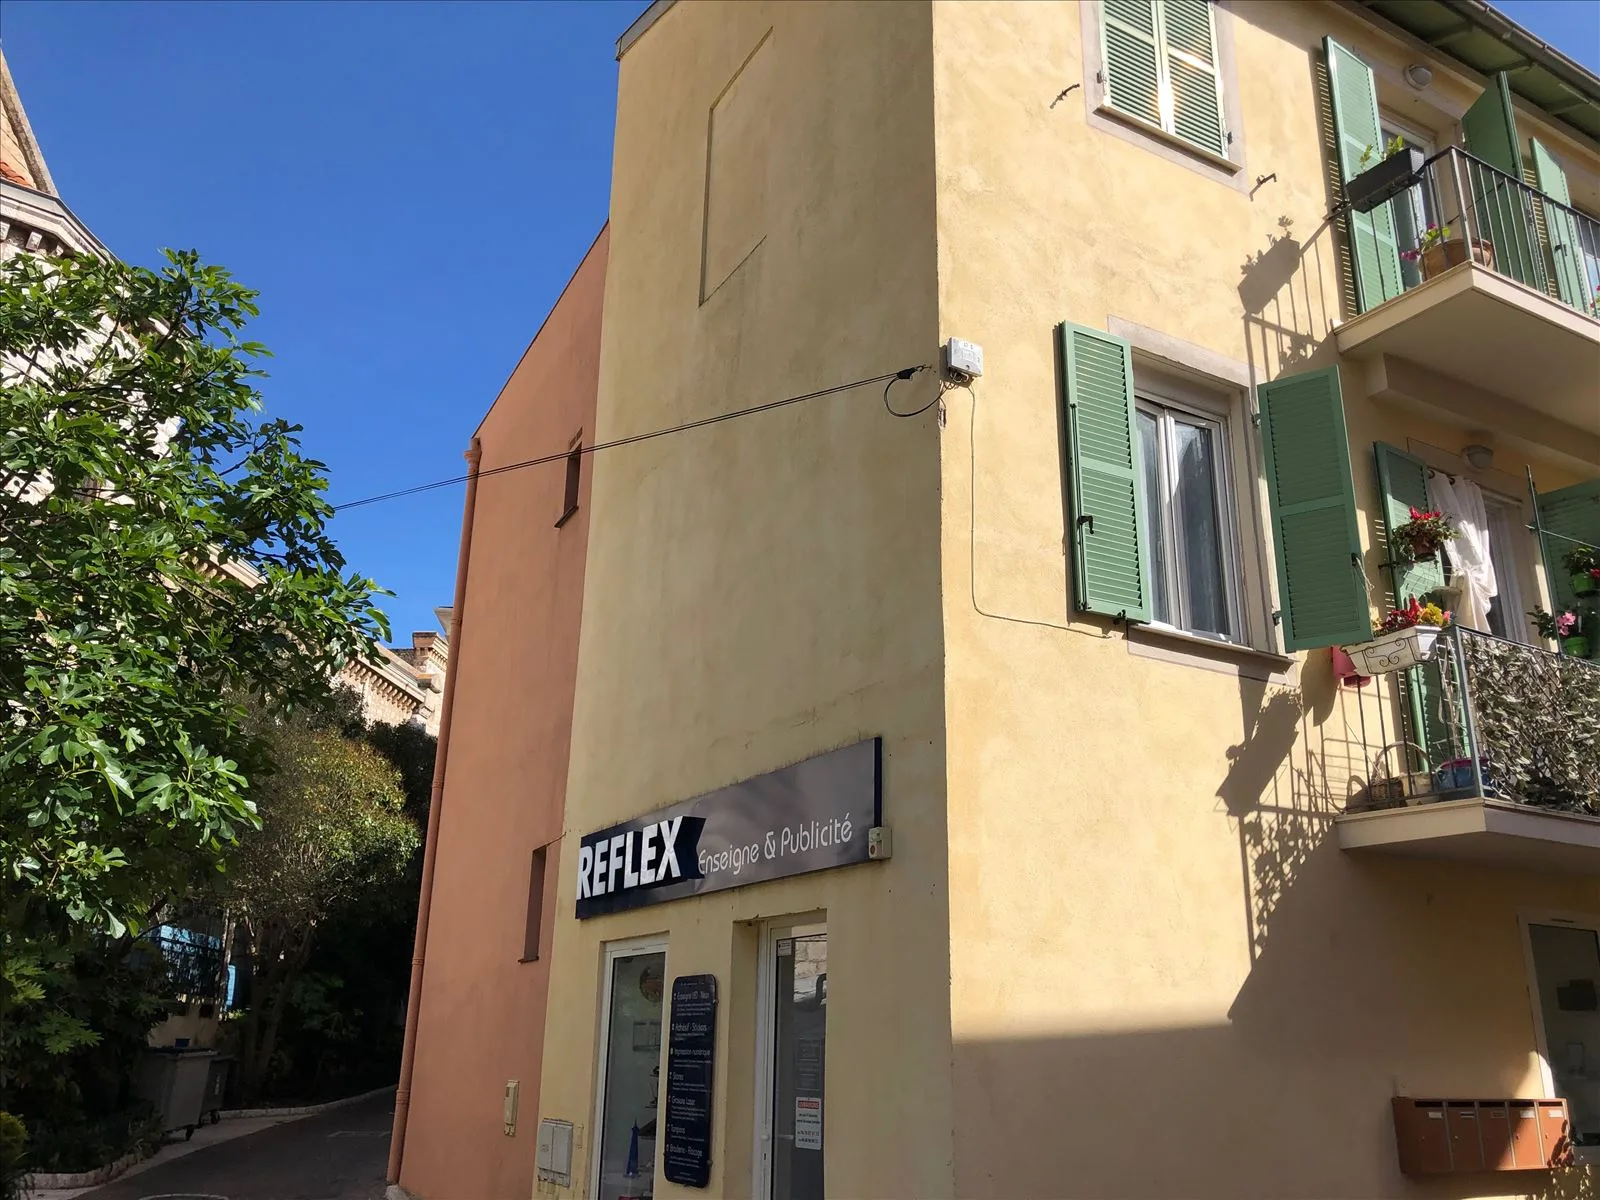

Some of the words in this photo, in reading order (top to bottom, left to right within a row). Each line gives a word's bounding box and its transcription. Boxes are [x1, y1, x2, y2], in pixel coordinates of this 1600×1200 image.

[576, 815, 684, 900] REFLEX
[698, 843, 760, 876] Enseigne
[763, 831, 776, 858] &
[781, 812, 853, 857] Publicité
